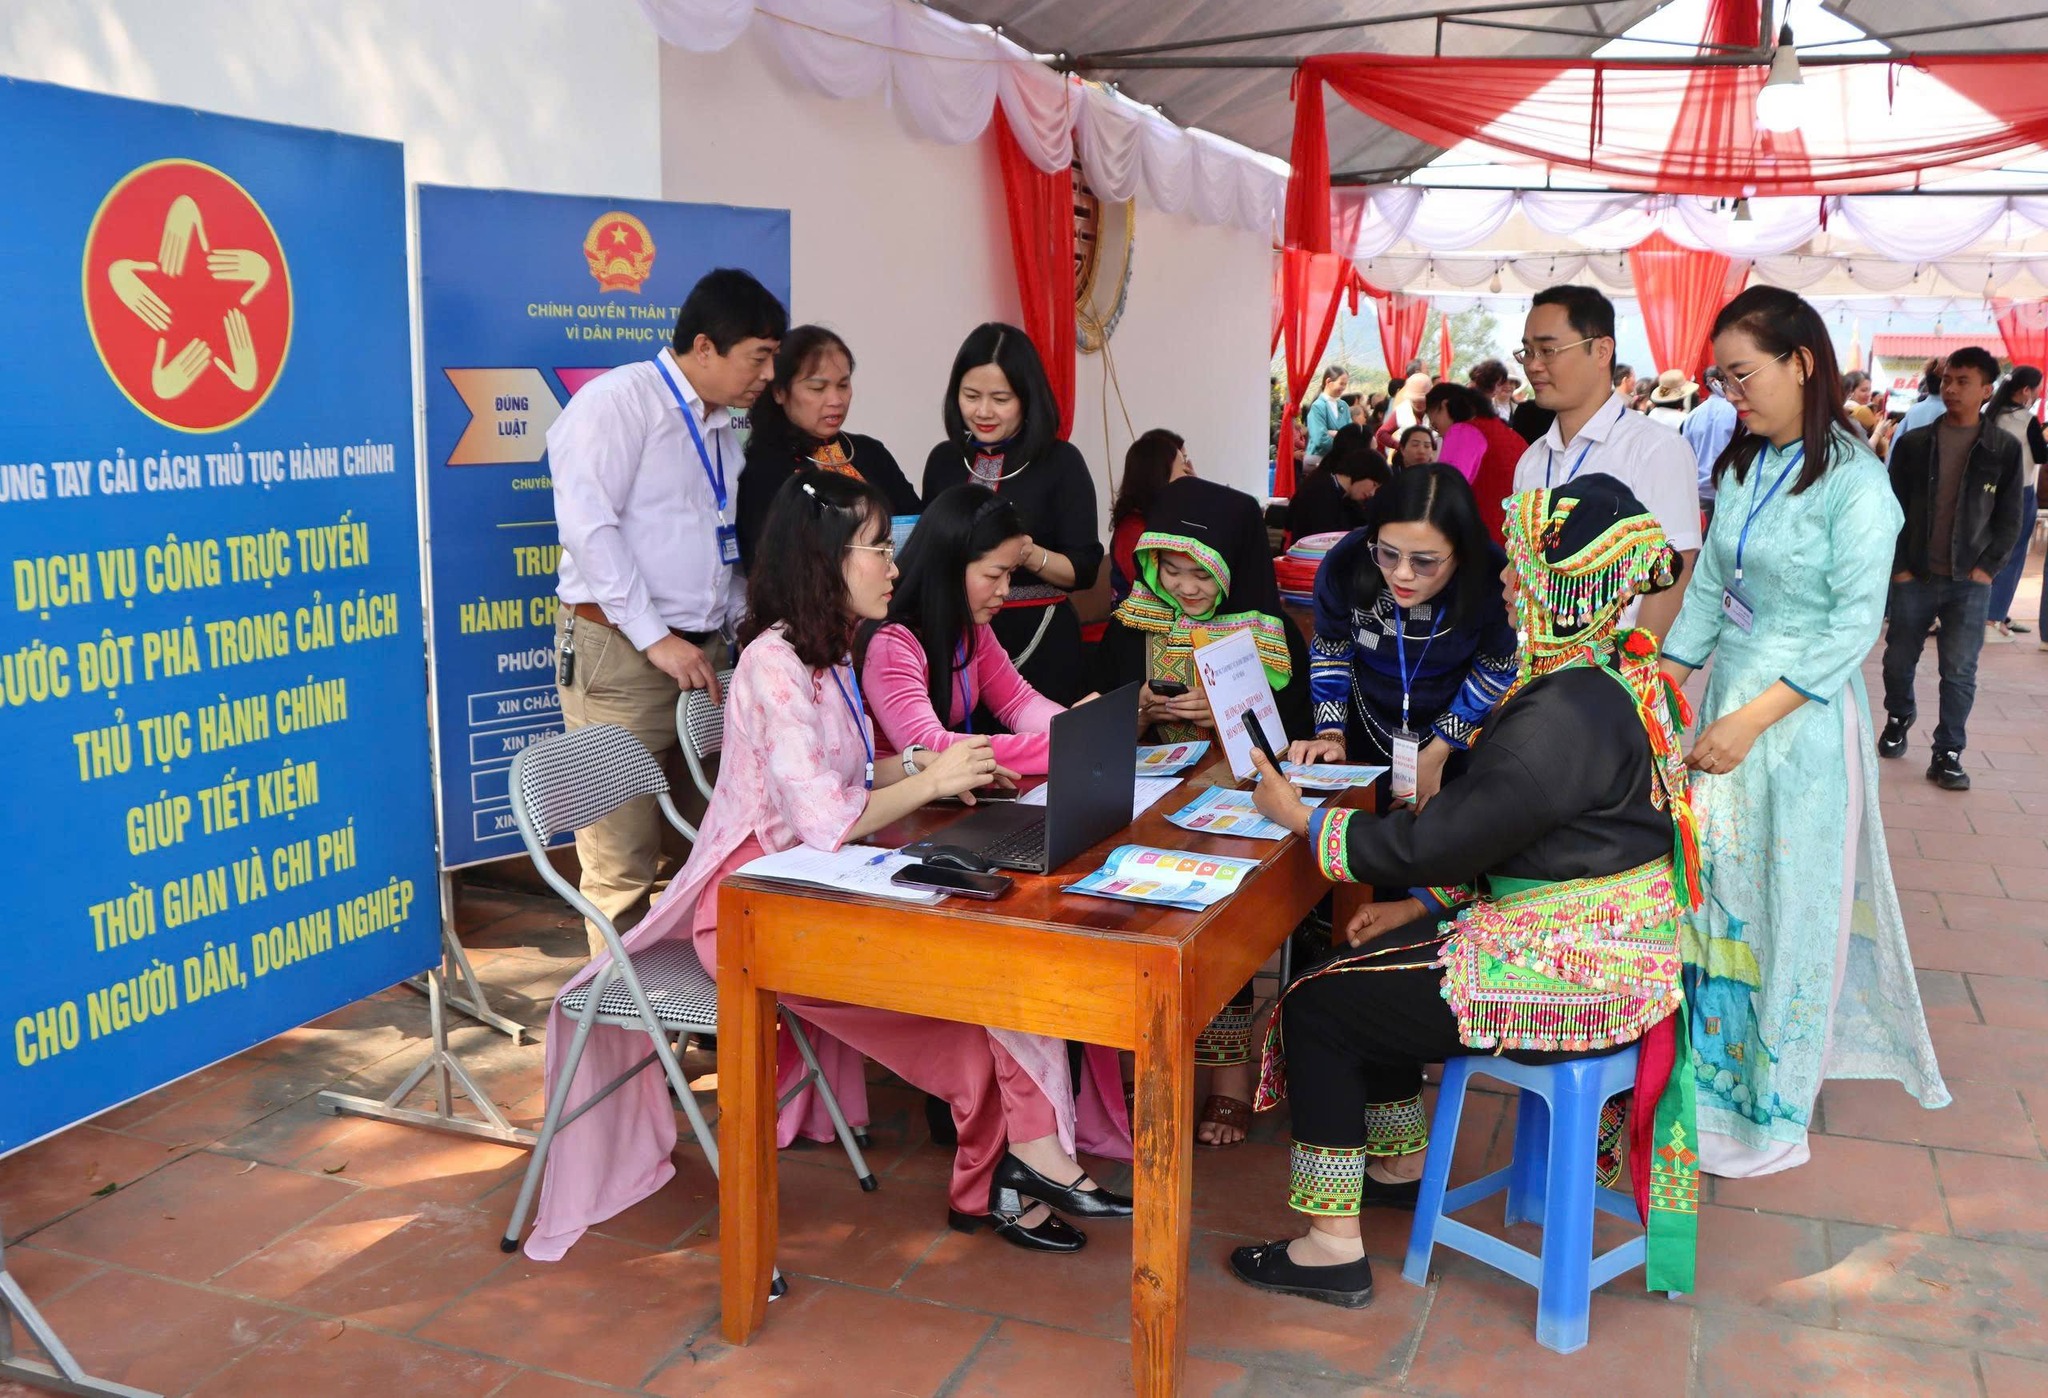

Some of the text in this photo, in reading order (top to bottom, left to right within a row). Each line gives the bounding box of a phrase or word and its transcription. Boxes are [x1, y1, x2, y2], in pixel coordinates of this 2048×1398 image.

[527, 302, 573, 318] CHÍNH
[577, 300, 625, 318] QUYỀN
[629, 303, 666, 319] THÂN
[566, 324, 674, 343] VÌ DÂN PHỤC VỤ
[495, 394, 529, 411] ĐÚNG
[498, 418, 527, 438] LUẬT
[51, 460, 91, 497] TAY
[98, 447, 137, 495] CẢI
[143, 449, 201, 491] CÁCH
[205, 441, 244, 487] THỦ
[248, 450, 285, 490] TỤC
[289, 442, 339, 480] HÀNH
[343, 438, 395, 476] CHÍNH
[13, 509, 369, 620] DỊCH VỤ CÔNG TRỰC TUYẾN
[460, 596, 523, 634] HÀNH
[78, 628, 134, 699] ĐỘT
[142, 615, 201, 681] PHÁ
[205, 608, 290, 668] TRONG
[295, 590, 334, 651] CẢI
[340, 588, 398, 644] CÁCH
[497, 691, 560, 714] XIN CHÀO
[73, 675, 347, 782] THỦ TỤC HÀNH CHÍNH
[502, 734, 525, 751] XIN
[126, 758, 318, 856] GIÚP TIẾT KIỆM
[89, 816, 357, 952] THỜI GIAN VÀ CHI PHÍ
[14, 876, 414, 1067] CHO NGƯỜI DÂN, DOANH NGHIỆP
